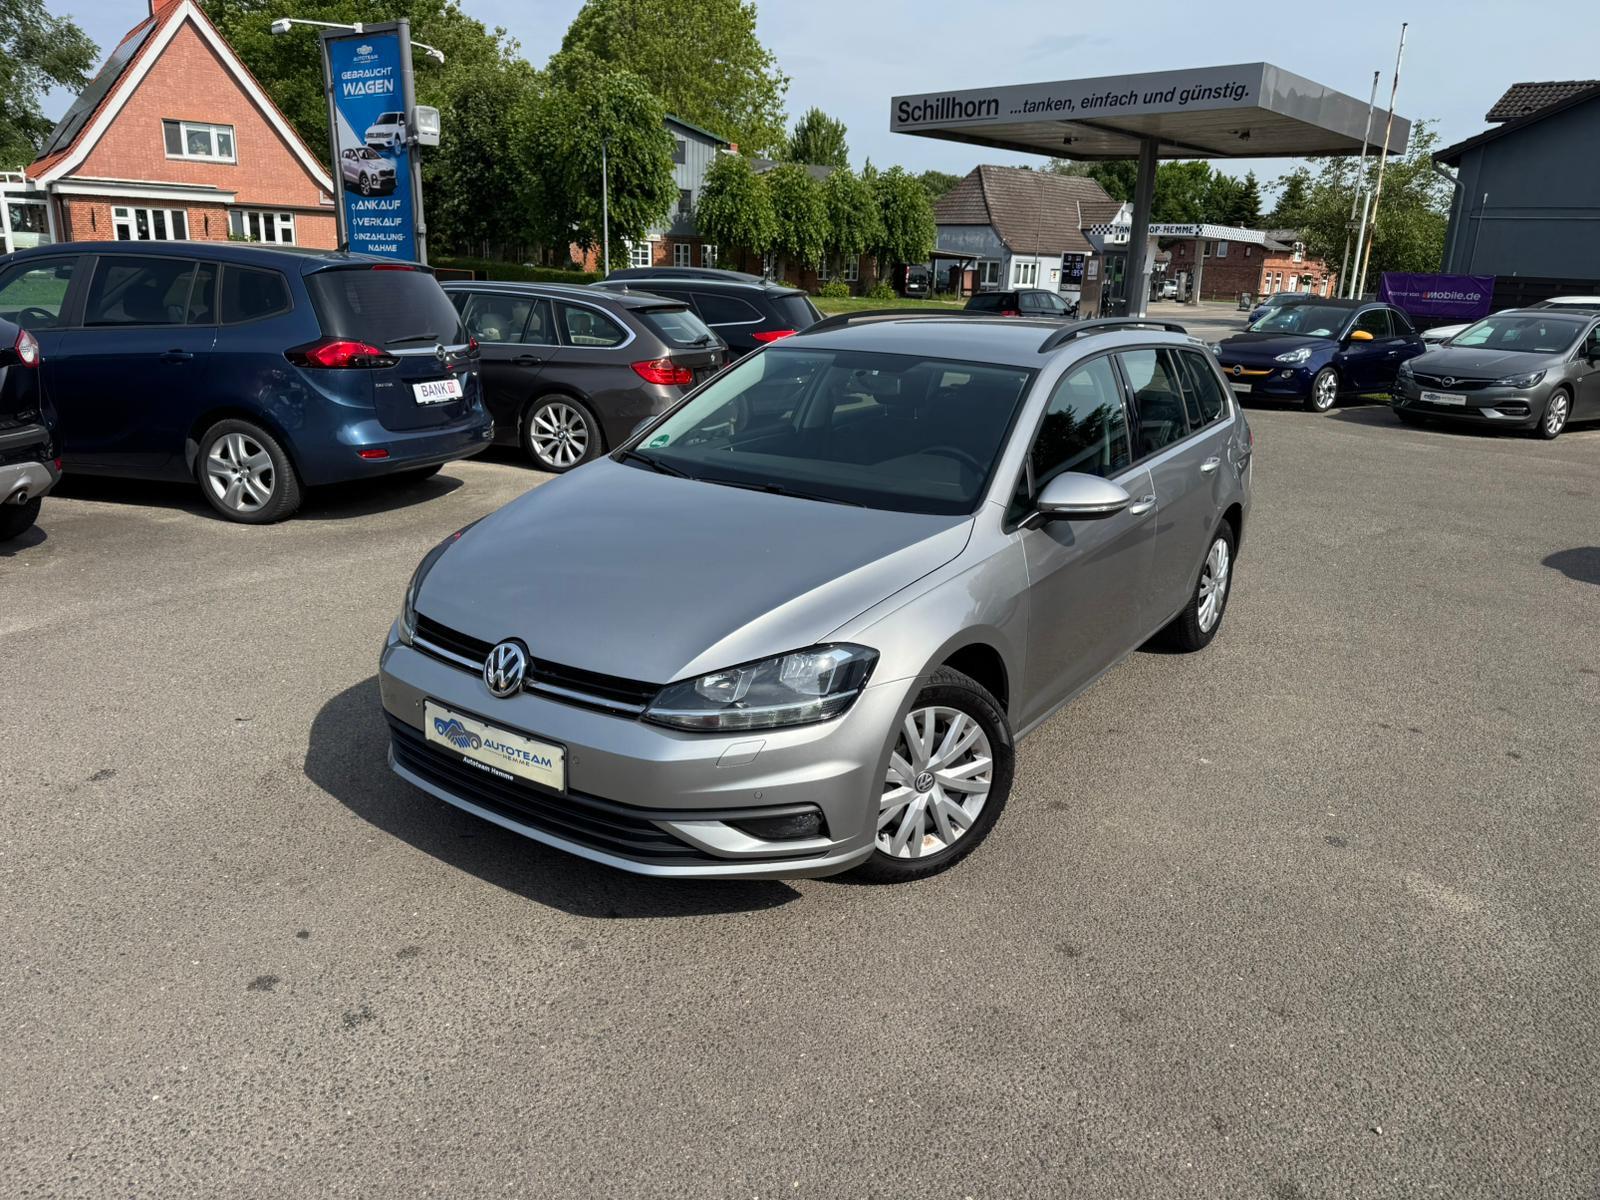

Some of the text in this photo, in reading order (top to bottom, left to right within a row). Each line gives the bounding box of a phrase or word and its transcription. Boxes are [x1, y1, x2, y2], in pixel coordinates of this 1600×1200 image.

[341, 67, 392, 80] GEBRAUCHT
[343, 79, 394, 96] WAGEN
[1080, 91, 1138, 109] einfach
[1142, 86, 1176, 105] und
[1179, 81, 1250, 104] günstig.
[897, 97, 1000, 123] Schillhorn
[356, 200, 401, 210] ANKAUF
[357, 217, 402, 226] VERKAUF
[368, 244, 398, 252] NAHME
[483, 738, 553, 768] AUTOTEAM
[502, 753, 530, 767] HEMME
[463, 756, 514, 781] Autoteam Hemme
